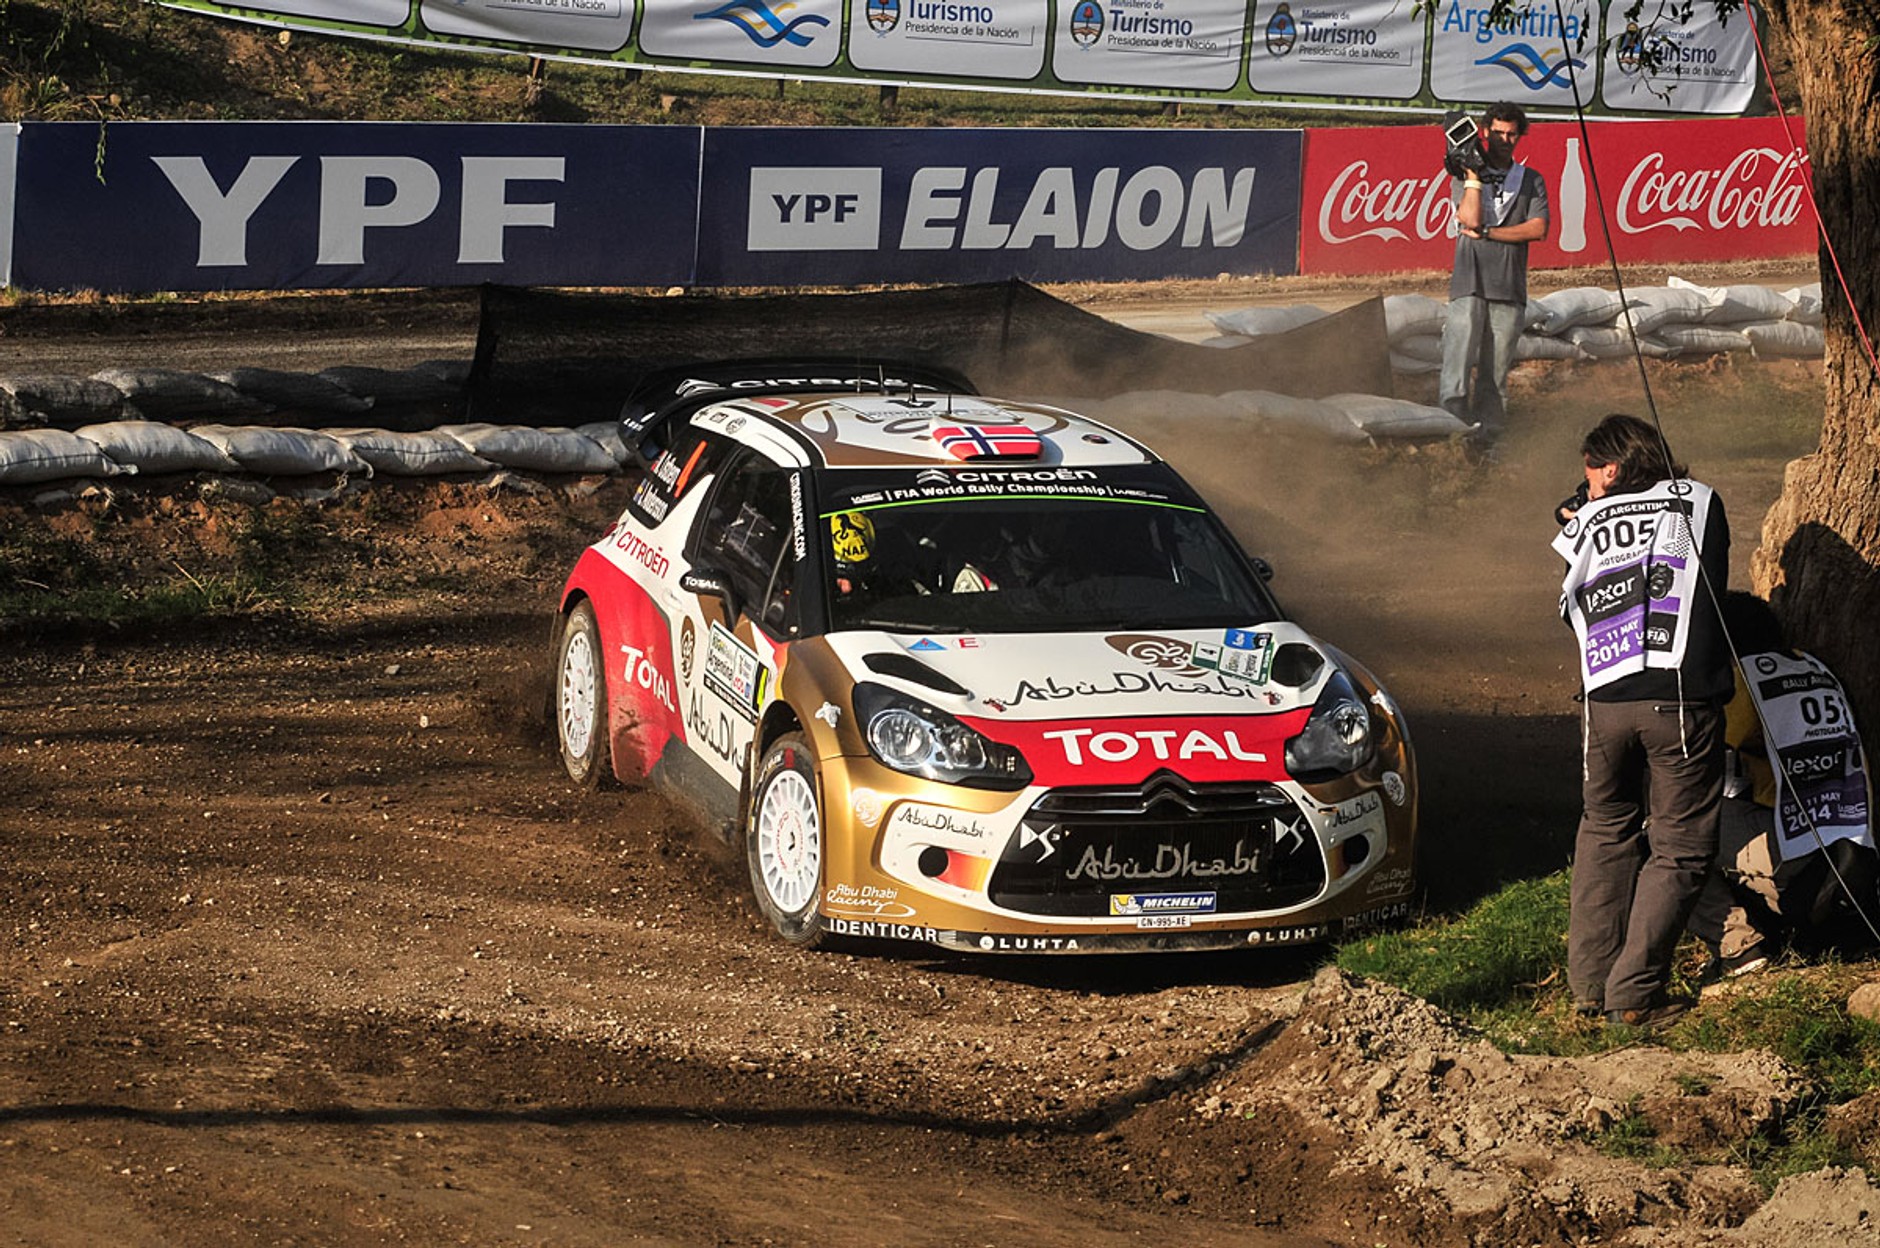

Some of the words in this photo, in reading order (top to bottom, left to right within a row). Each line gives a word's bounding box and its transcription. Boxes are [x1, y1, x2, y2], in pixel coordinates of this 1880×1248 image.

[909, 0, 993, 24] Turismo
[1110, 0, 1151, 8] Ministerio
[1153, 0, 1164, 9] de
[1302, 9, 1339, 20] Ministerio
[905, 21, 959, 35] Presidencia
[961, 26, 973, 36] de
[975, 27, 984, 37] la
[986, 27, 1020, 39] Nación
[1109, 10, 1193, 36] Turismo
[1301, 21, 1377, 46] Turismo
[1686, 30, 1695, 39] de
[1107, 35, 1159, 48] Presidencia
[1161, 37, 1173, 48] de
[1175, 39, 1184, 48] la
[1186, 39, 1217, 51] Nación
[1299, 45, 1347, 57] Presidencia
[1349, 48, 1360, 58] de
[1361, 49, 1370, 58] la
[1372, 50, 1400, 60] Nación
[1319, 160, 1459, 244] Coca-C
[1617, 147, 1809, 234] Coca-Cola
[150, 156, 566, 267] YPF
[771, 194, 859, 223] YPF
[899, 166, 1257, 250] ELAION
[894, 489, 919, 500] FIA
[921, 484, 965, 496] World
[967, 483, 1004, 494] Rally
[1007, 483, 1106, 496] Championship
[1610, 501, 1670, 516] ARGENTINA
[1592, 519, 1655, 556] 005
[685, 576, 720, 590] TOTAL
[1606, 629, 1618, 641] 11
[1620, 619, 1639, 635] MAY
[1647, 630, 1666, 642] FIA
[1588, 636, 1631, 668] 2014
[620, 644, 676, 713] TOTAL
[1043, 729, 1267, 765] TOTAL
[1820, 792, 1841, 803] MAY
[1786, 804, 1832, 832] 2014
[826, 889, 894, 914] Racing
[836, 883, 858, 897] Abu
[861, 886, 899, 900] Dhabi
[1143, 896, 1214, 908] MICHELIN
[1343, 903, 1408, 929] IDENTICAR
[830, 918, 937, 942] IDENTICAR
[999, 938, 1079, 949] LUHTA
